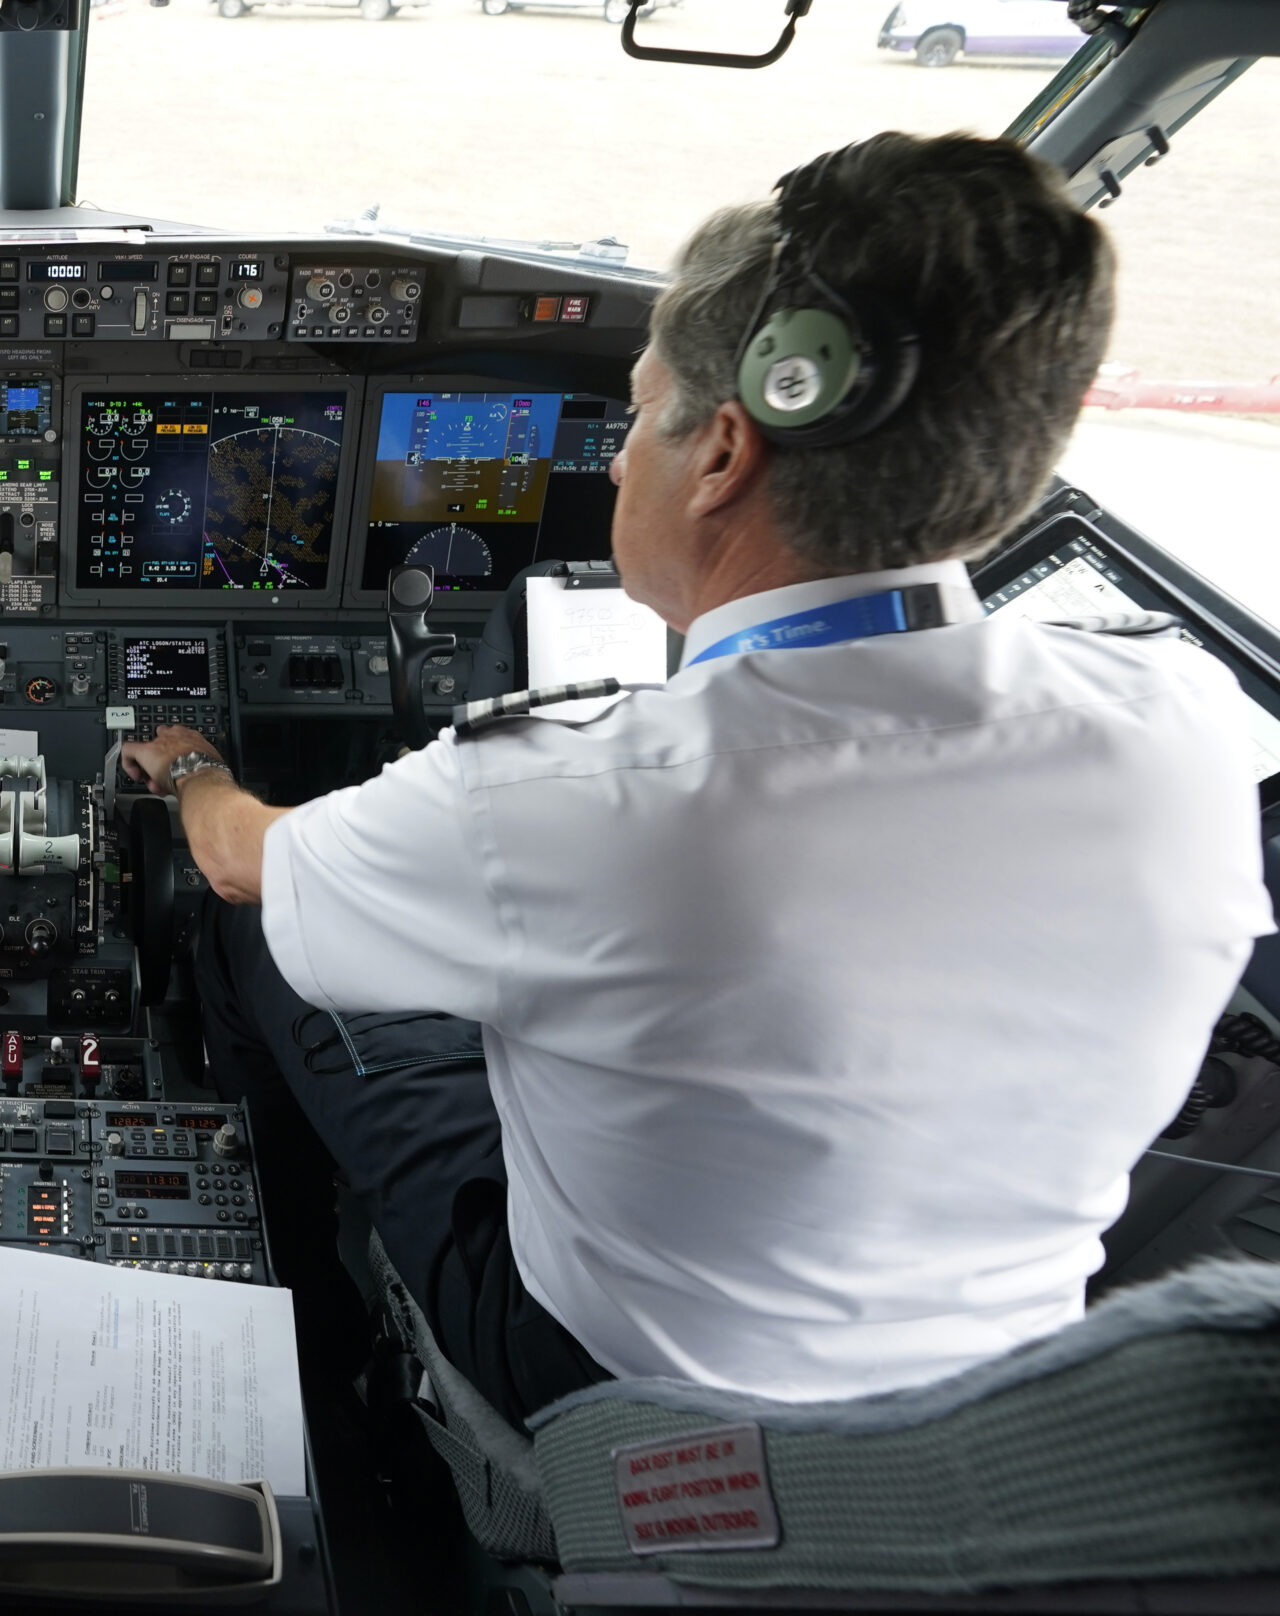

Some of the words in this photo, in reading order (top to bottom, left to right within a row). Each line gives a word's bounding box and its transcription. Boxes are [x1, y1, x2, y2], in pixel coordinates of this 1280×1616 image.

[47, 265, 81, 278] 10000
[238, 264, 258, 277] 176
[45, 841, 53, 854] 2
[77, 925, 87, 933] 40
[7, 1035, 17, 1064] APU
[82, 1038, 99, 1066] 2
[246, 1184, 255, 1202] NAV
[630, 1456, 651, 1476] BACK
[651, 1451, 673, 1470] REST
[676, 1445, 702, 1465] MUST
[705, 1441, 720, 1461] BE
[722, 1440, 736, 1457] IN
[651, 1483, 679, 1503] FLIGHT
[680, 1477, 725, 1498] POSITION
[726, 1471, 761, 1491] WHEN
[665, 1514, 700, 1535] MOVING
[700, 1508, 759, 1532] OUTBOARD
